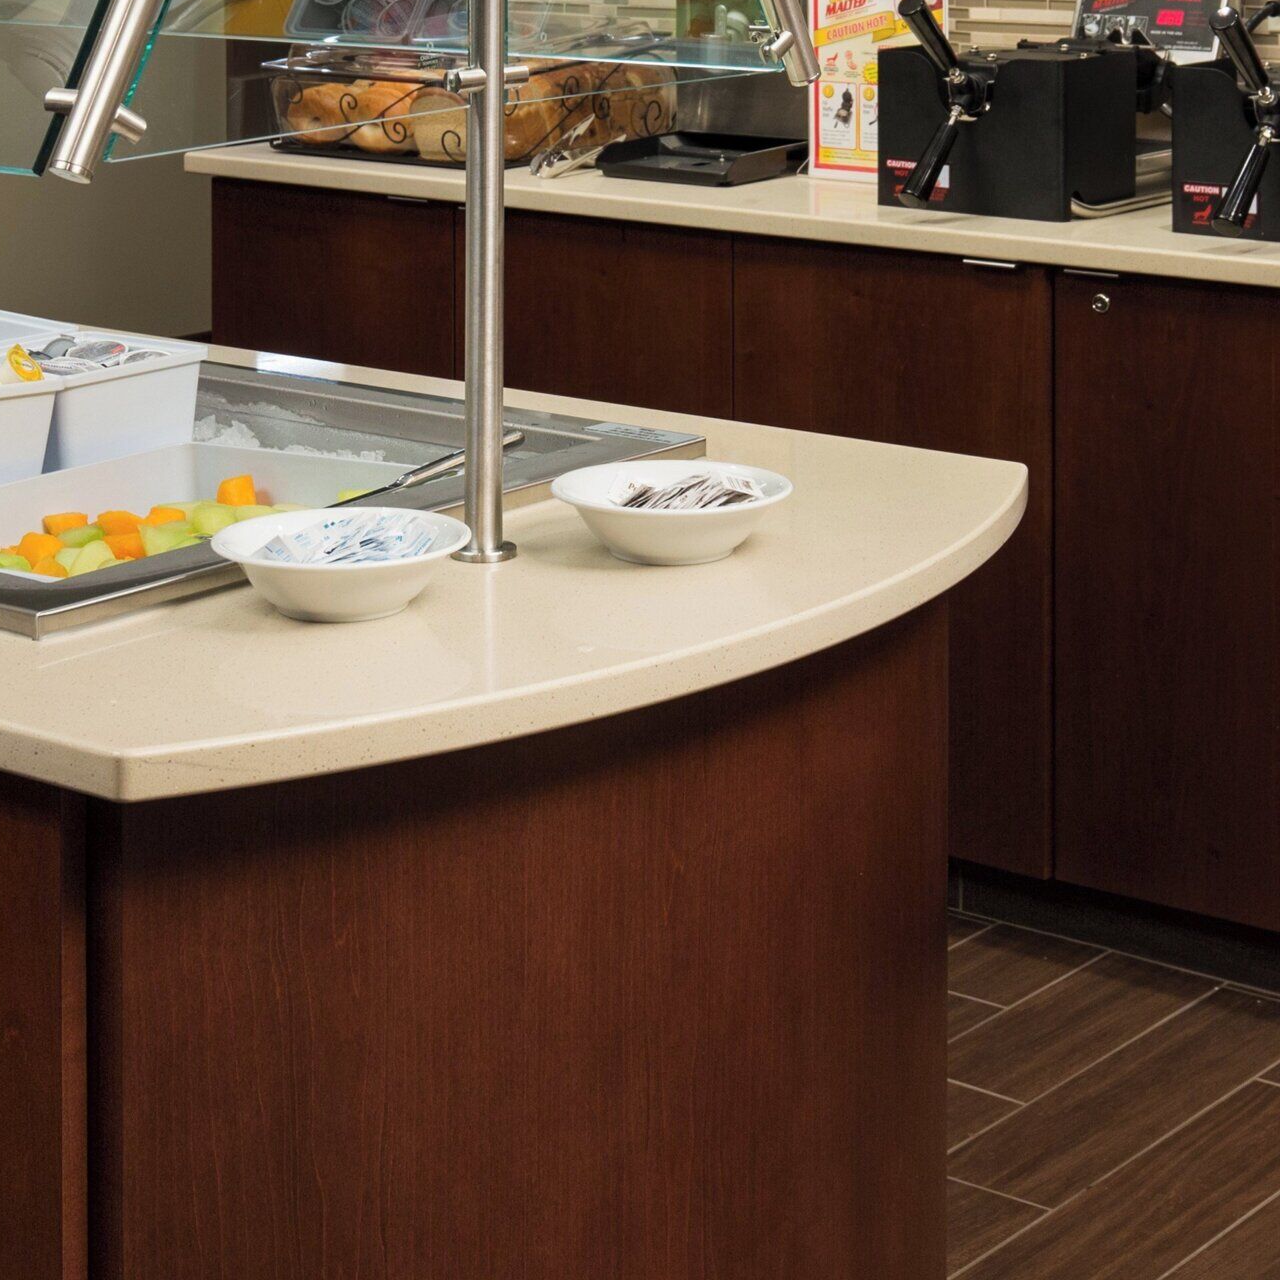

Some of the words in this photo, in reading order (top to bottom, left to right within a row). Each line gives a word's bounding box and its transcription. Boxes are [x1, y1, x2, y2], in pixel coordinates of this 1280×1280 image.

[826, 22, 865, 40] CAUTION
[865, 16, 887, 31] HOT!
[886, 159, 917, 169] CAUTION
[1183, 184, 1220, 194] CAUTION
